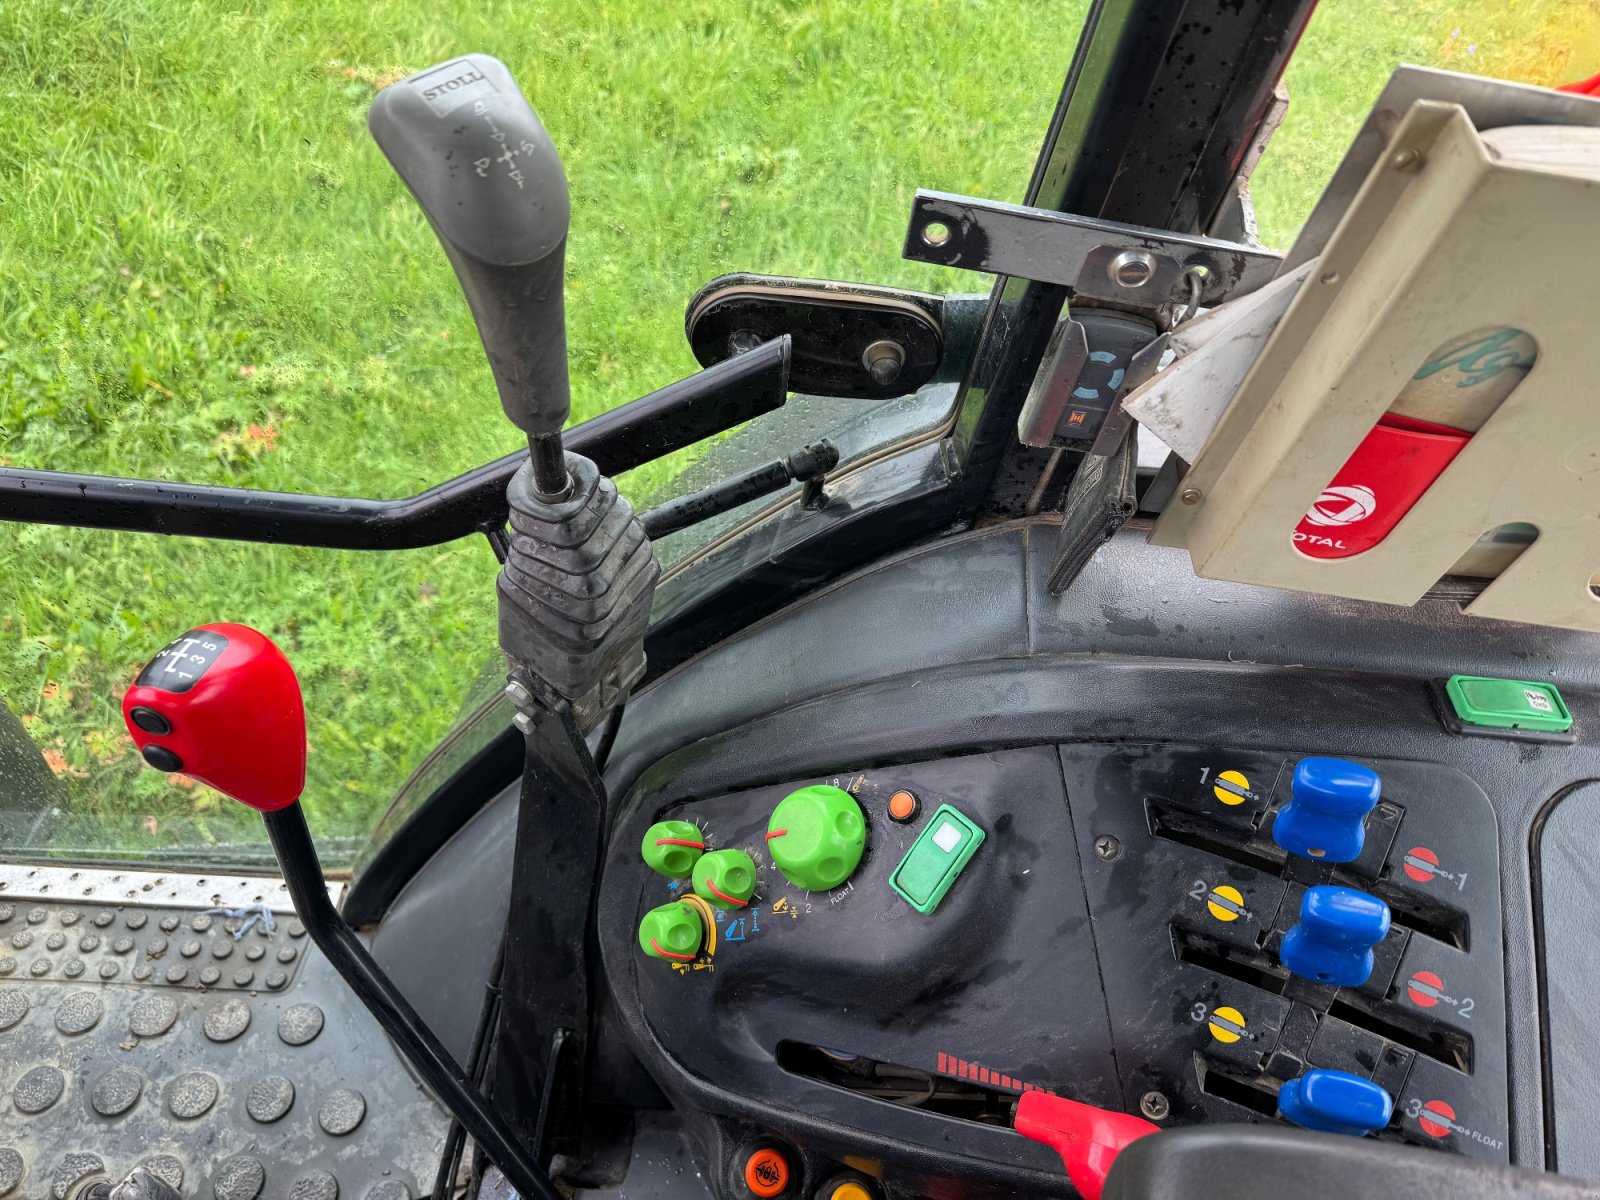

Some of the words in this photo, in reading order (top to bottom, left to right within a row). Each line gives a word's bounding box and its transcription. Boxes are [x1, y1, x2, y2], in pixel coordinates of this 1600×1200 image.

[423, 72, 484, 101] STOLL
[1293, 530, 1346, 549] OTAL
[178, 671, 193, 679] 1
[190, 654, 206, 665] 3
[202, 641, 217, 651] 5
[833, 778, 840, 788] 8
[1200, 767, 1210, 785] 1
[770, 862, 777, 871] 4
[1188, 880, 1208, 901] 2
[1457, 872, 1467, 891] 1
[830, 888, 850, 906] FLOAT
[805, 903, 812, 913] 2
[1190, 1002, 1207, 1022] 3
[1457, 998, 1475, 1019] 2
[1405, 1098, 1422, 1119] 3
[1471, 1130, 1503, 1150] FLOAT
